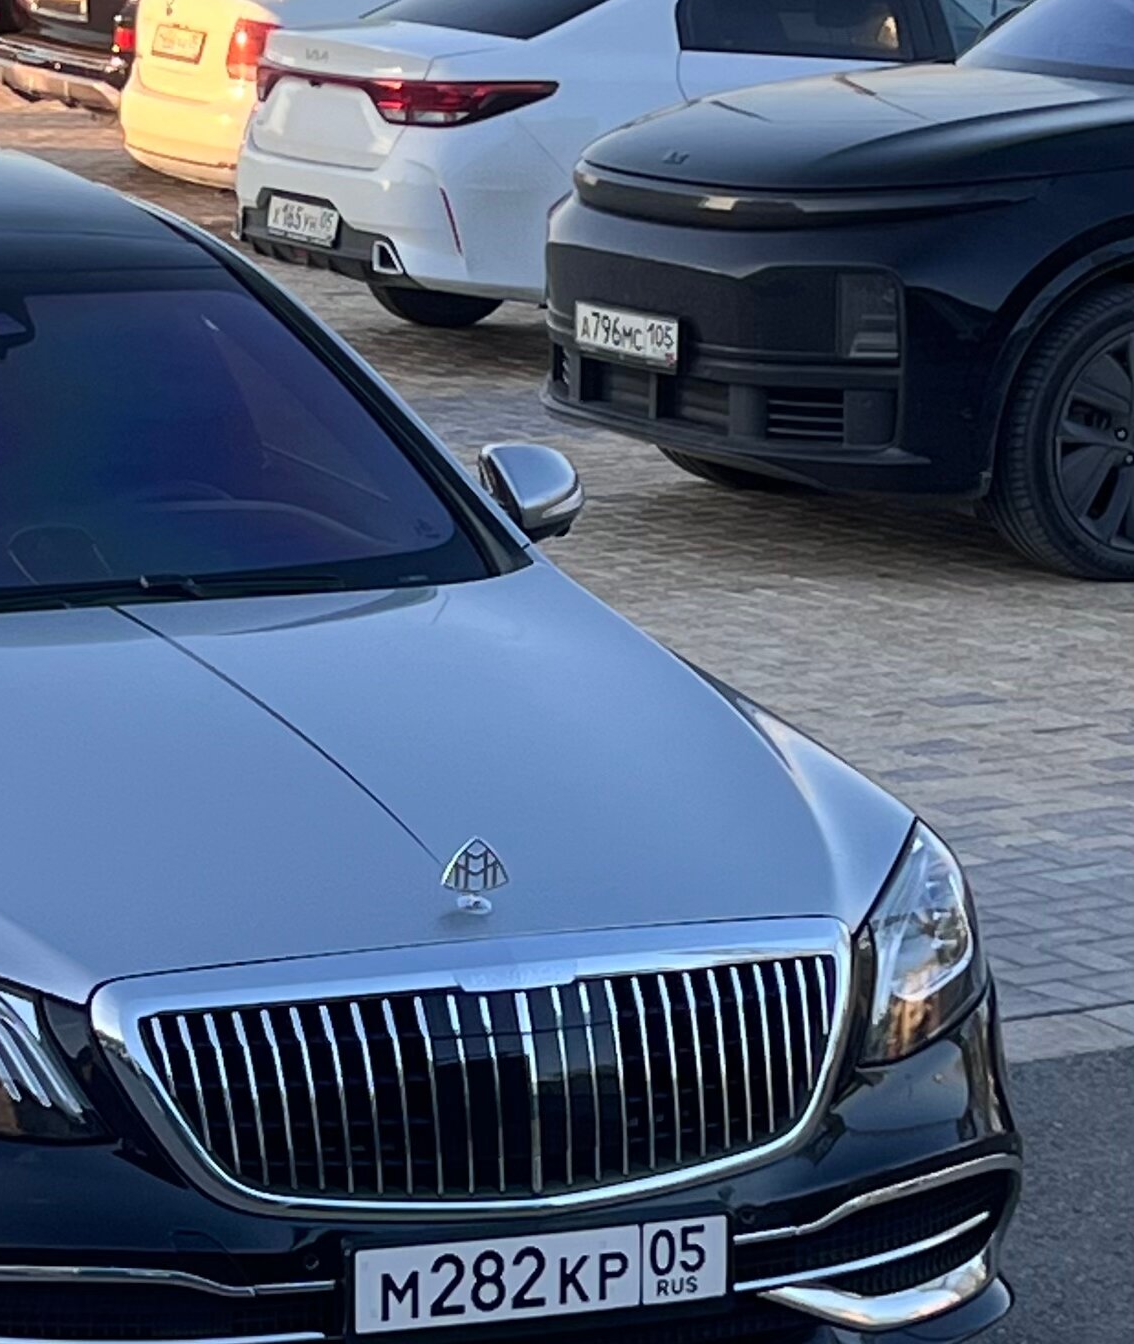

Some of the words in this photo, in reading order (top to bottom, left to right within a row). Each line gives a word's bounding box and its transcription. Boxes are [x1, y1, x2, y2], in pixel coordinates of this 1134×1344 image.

[580, 311, 642, 352] А796МС
[646, 322, 674, 350] 105
[380, 1245, 629, 1322] М282КР
[649, 1224, 706, 1277] 05
[656, 1276, 698, 1297] RUS
